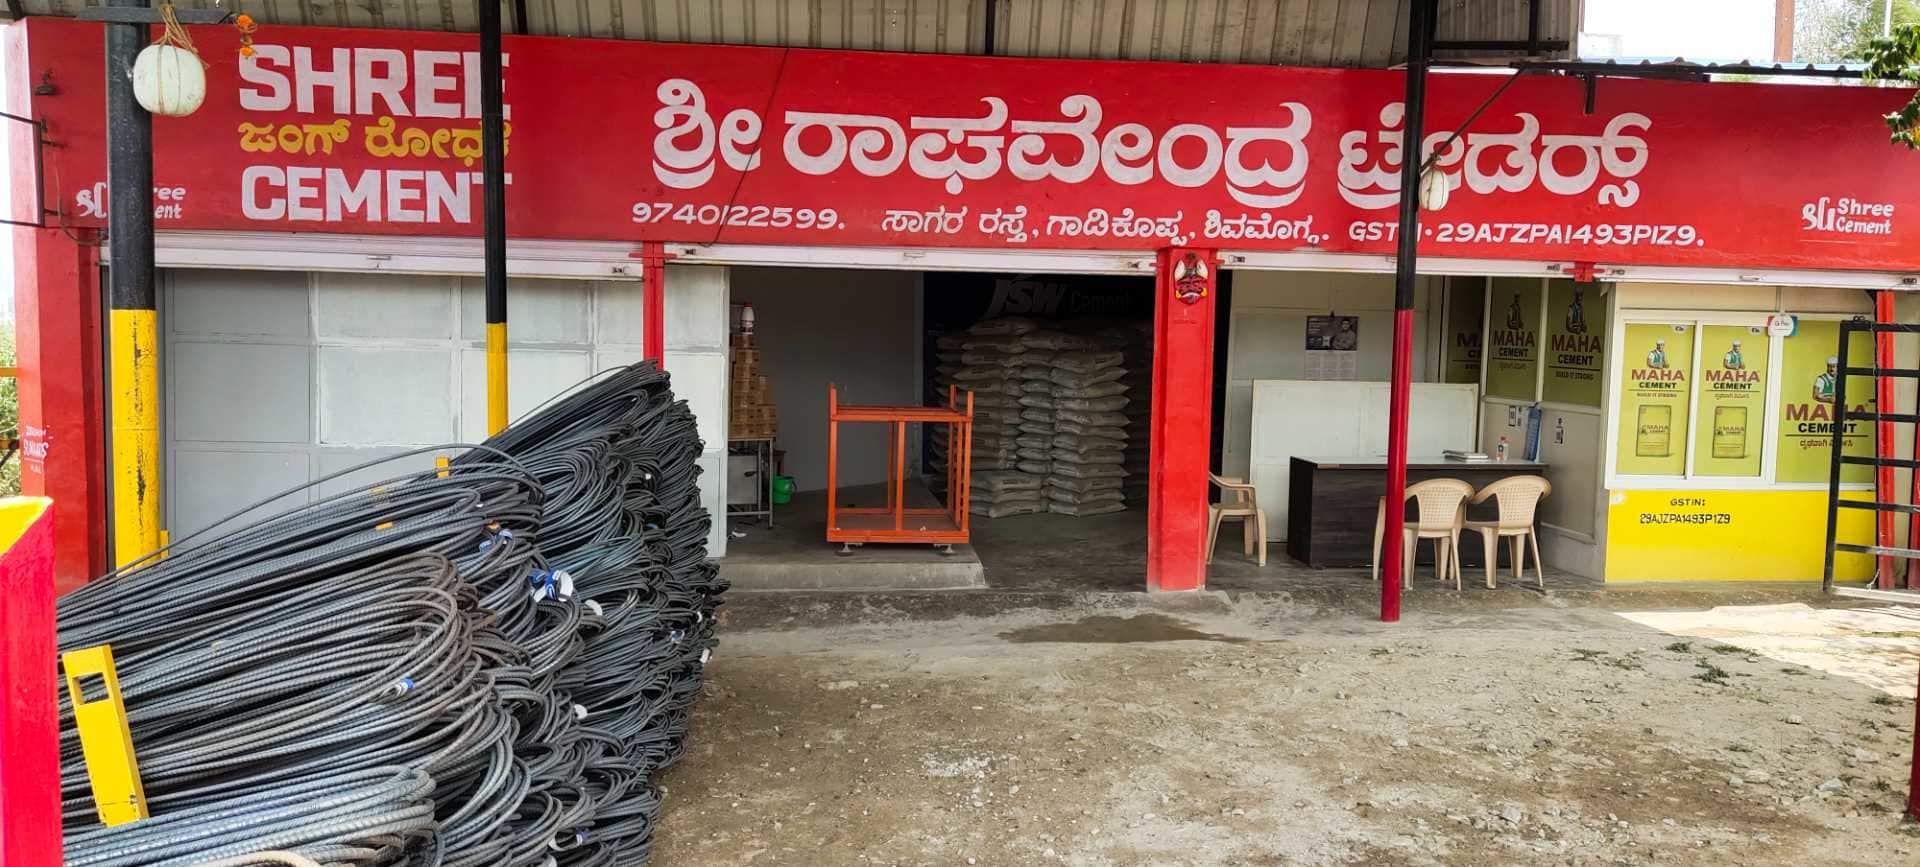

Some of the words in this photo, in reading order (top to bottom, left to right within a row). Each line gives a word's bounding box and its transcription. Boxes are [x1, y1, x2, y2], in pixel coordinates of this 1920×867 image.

[239, 44, 512, 120] SHREE
[238, 118, 351, 156] ಜಂಗ್
[653, 78, 762, 190] ಶ್ರೀ
[782, 94, 1313, 208] ರಾಘವೇಂದ್ರ
[1837, 197, 1895, 216] Shree
[881, 205, 968, 234] ಸಾಗರ
[1836, 216, 1892, 234] Cement
[1494, 330, 1535, 348] MAHA
[1552, 334, 1601, 353] MAHA
[1499, 347, 1529, 358] CEMENT
[1558, 354, 1594, 366] CEMENT
[1631, 369, 1685, 381] MAHA
[1706, 370, 1760, 382] MAHA
[1670, 498, 1705, 507] GSTIN:
